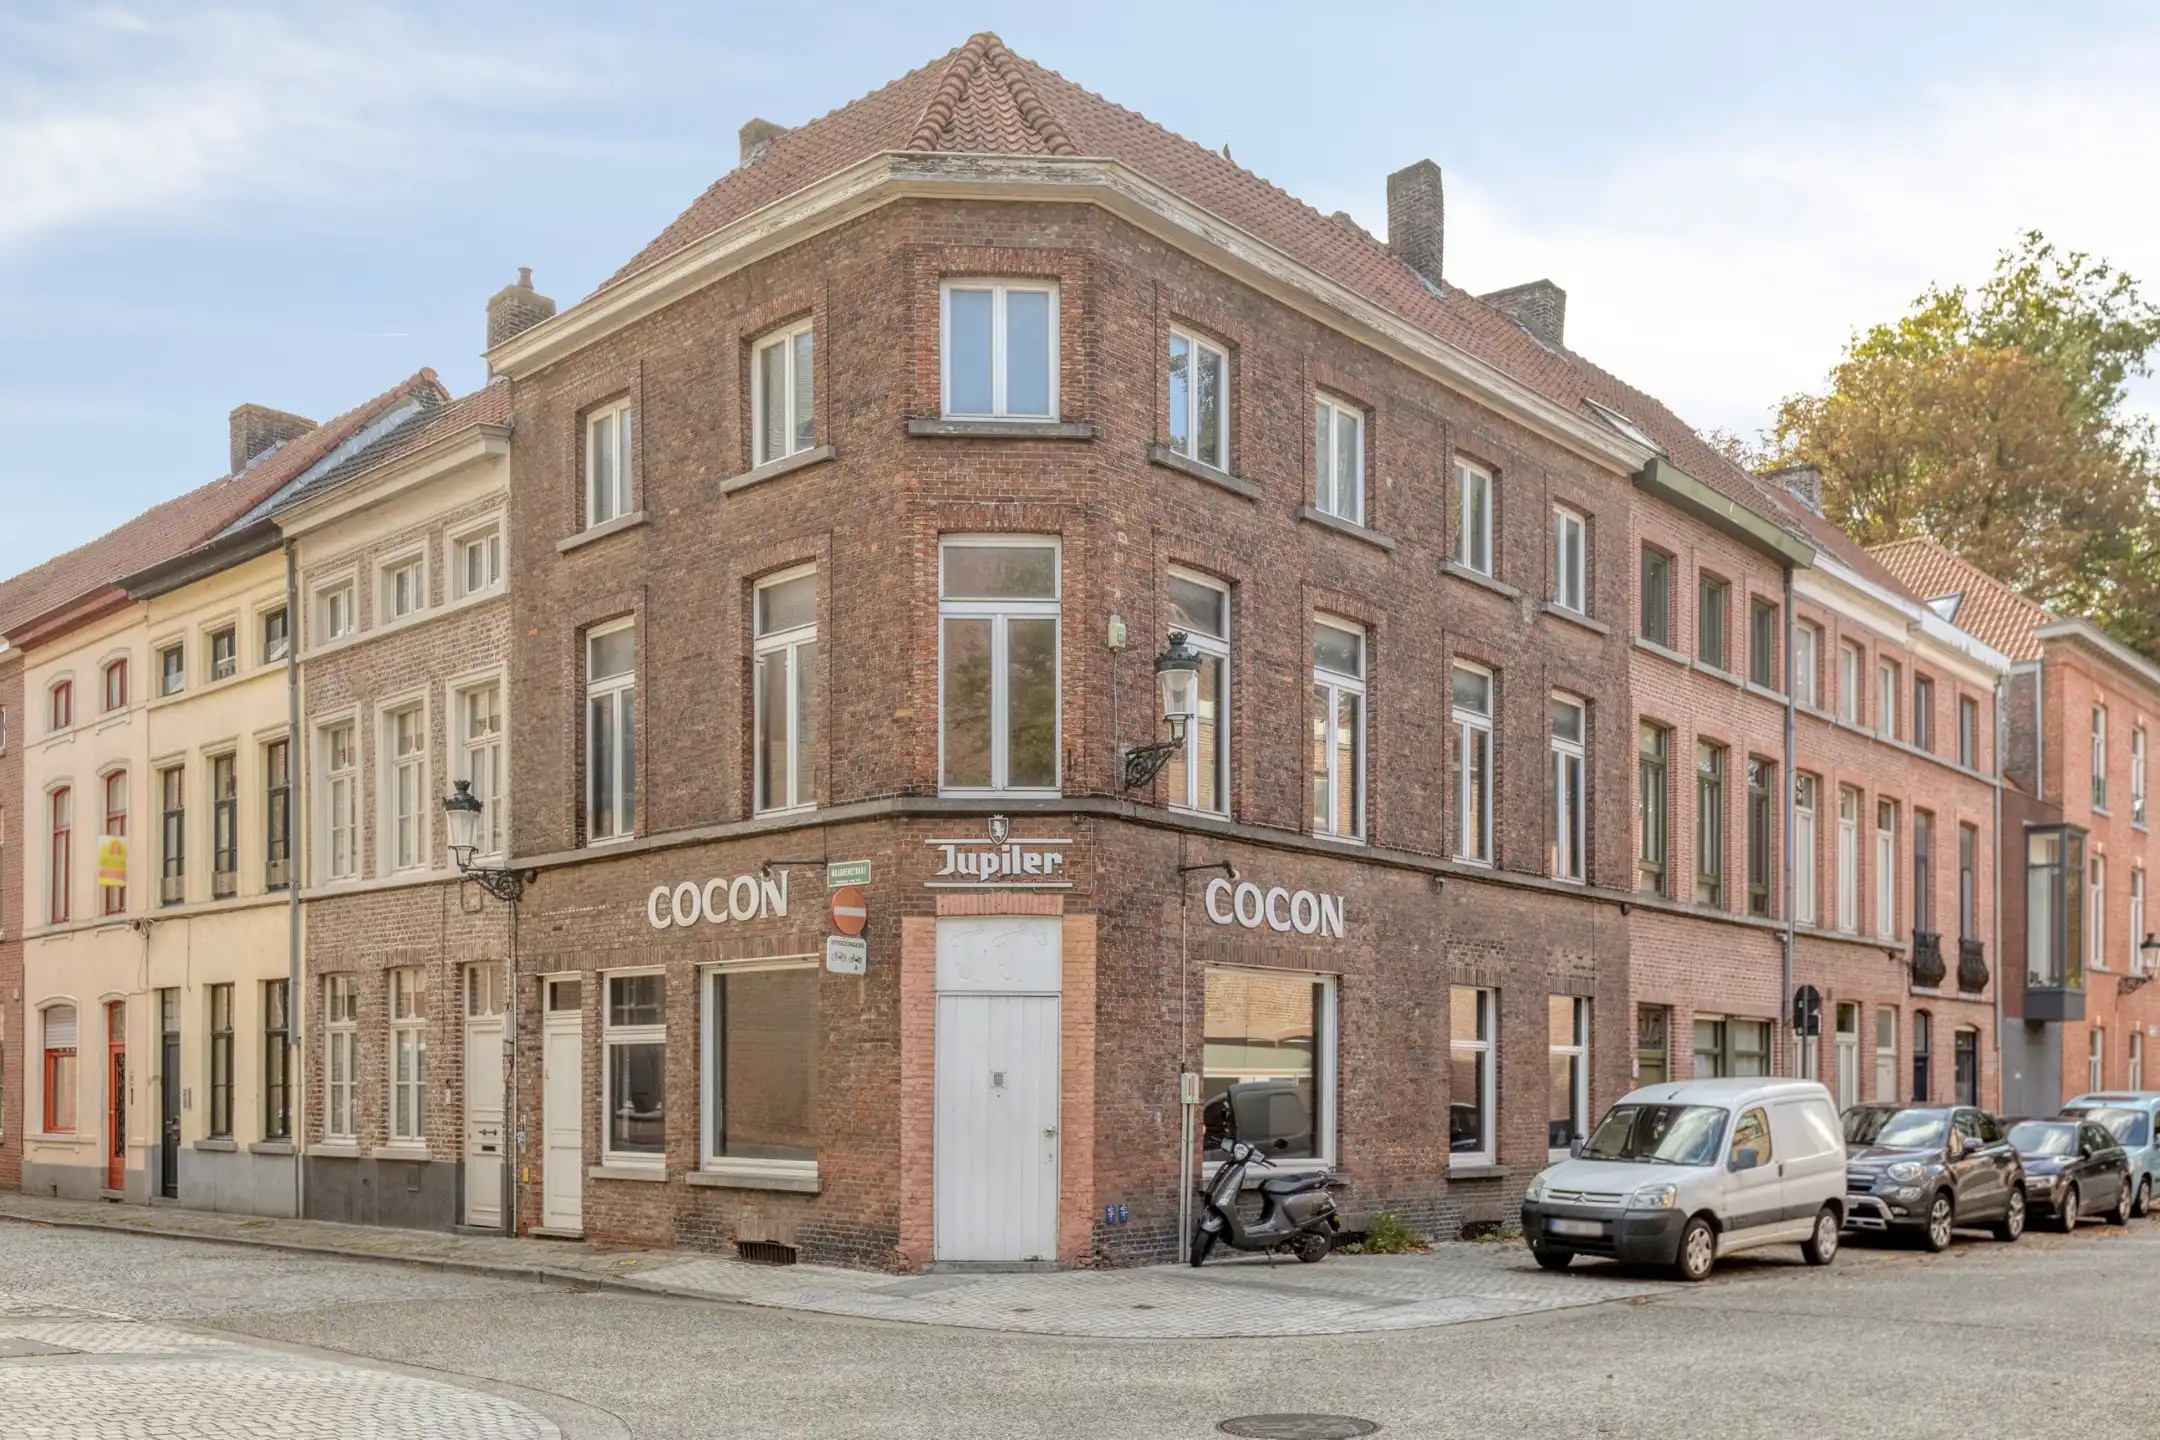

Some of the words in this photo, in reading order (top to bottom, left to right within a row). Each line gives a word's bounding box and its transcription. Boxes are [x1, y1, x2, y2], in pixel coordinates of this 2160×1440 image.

[935, 845, 1063, 881] Jupiler
[648, 869, 789, 929] COCON
[1205, 878, 1344, 938] COCON
